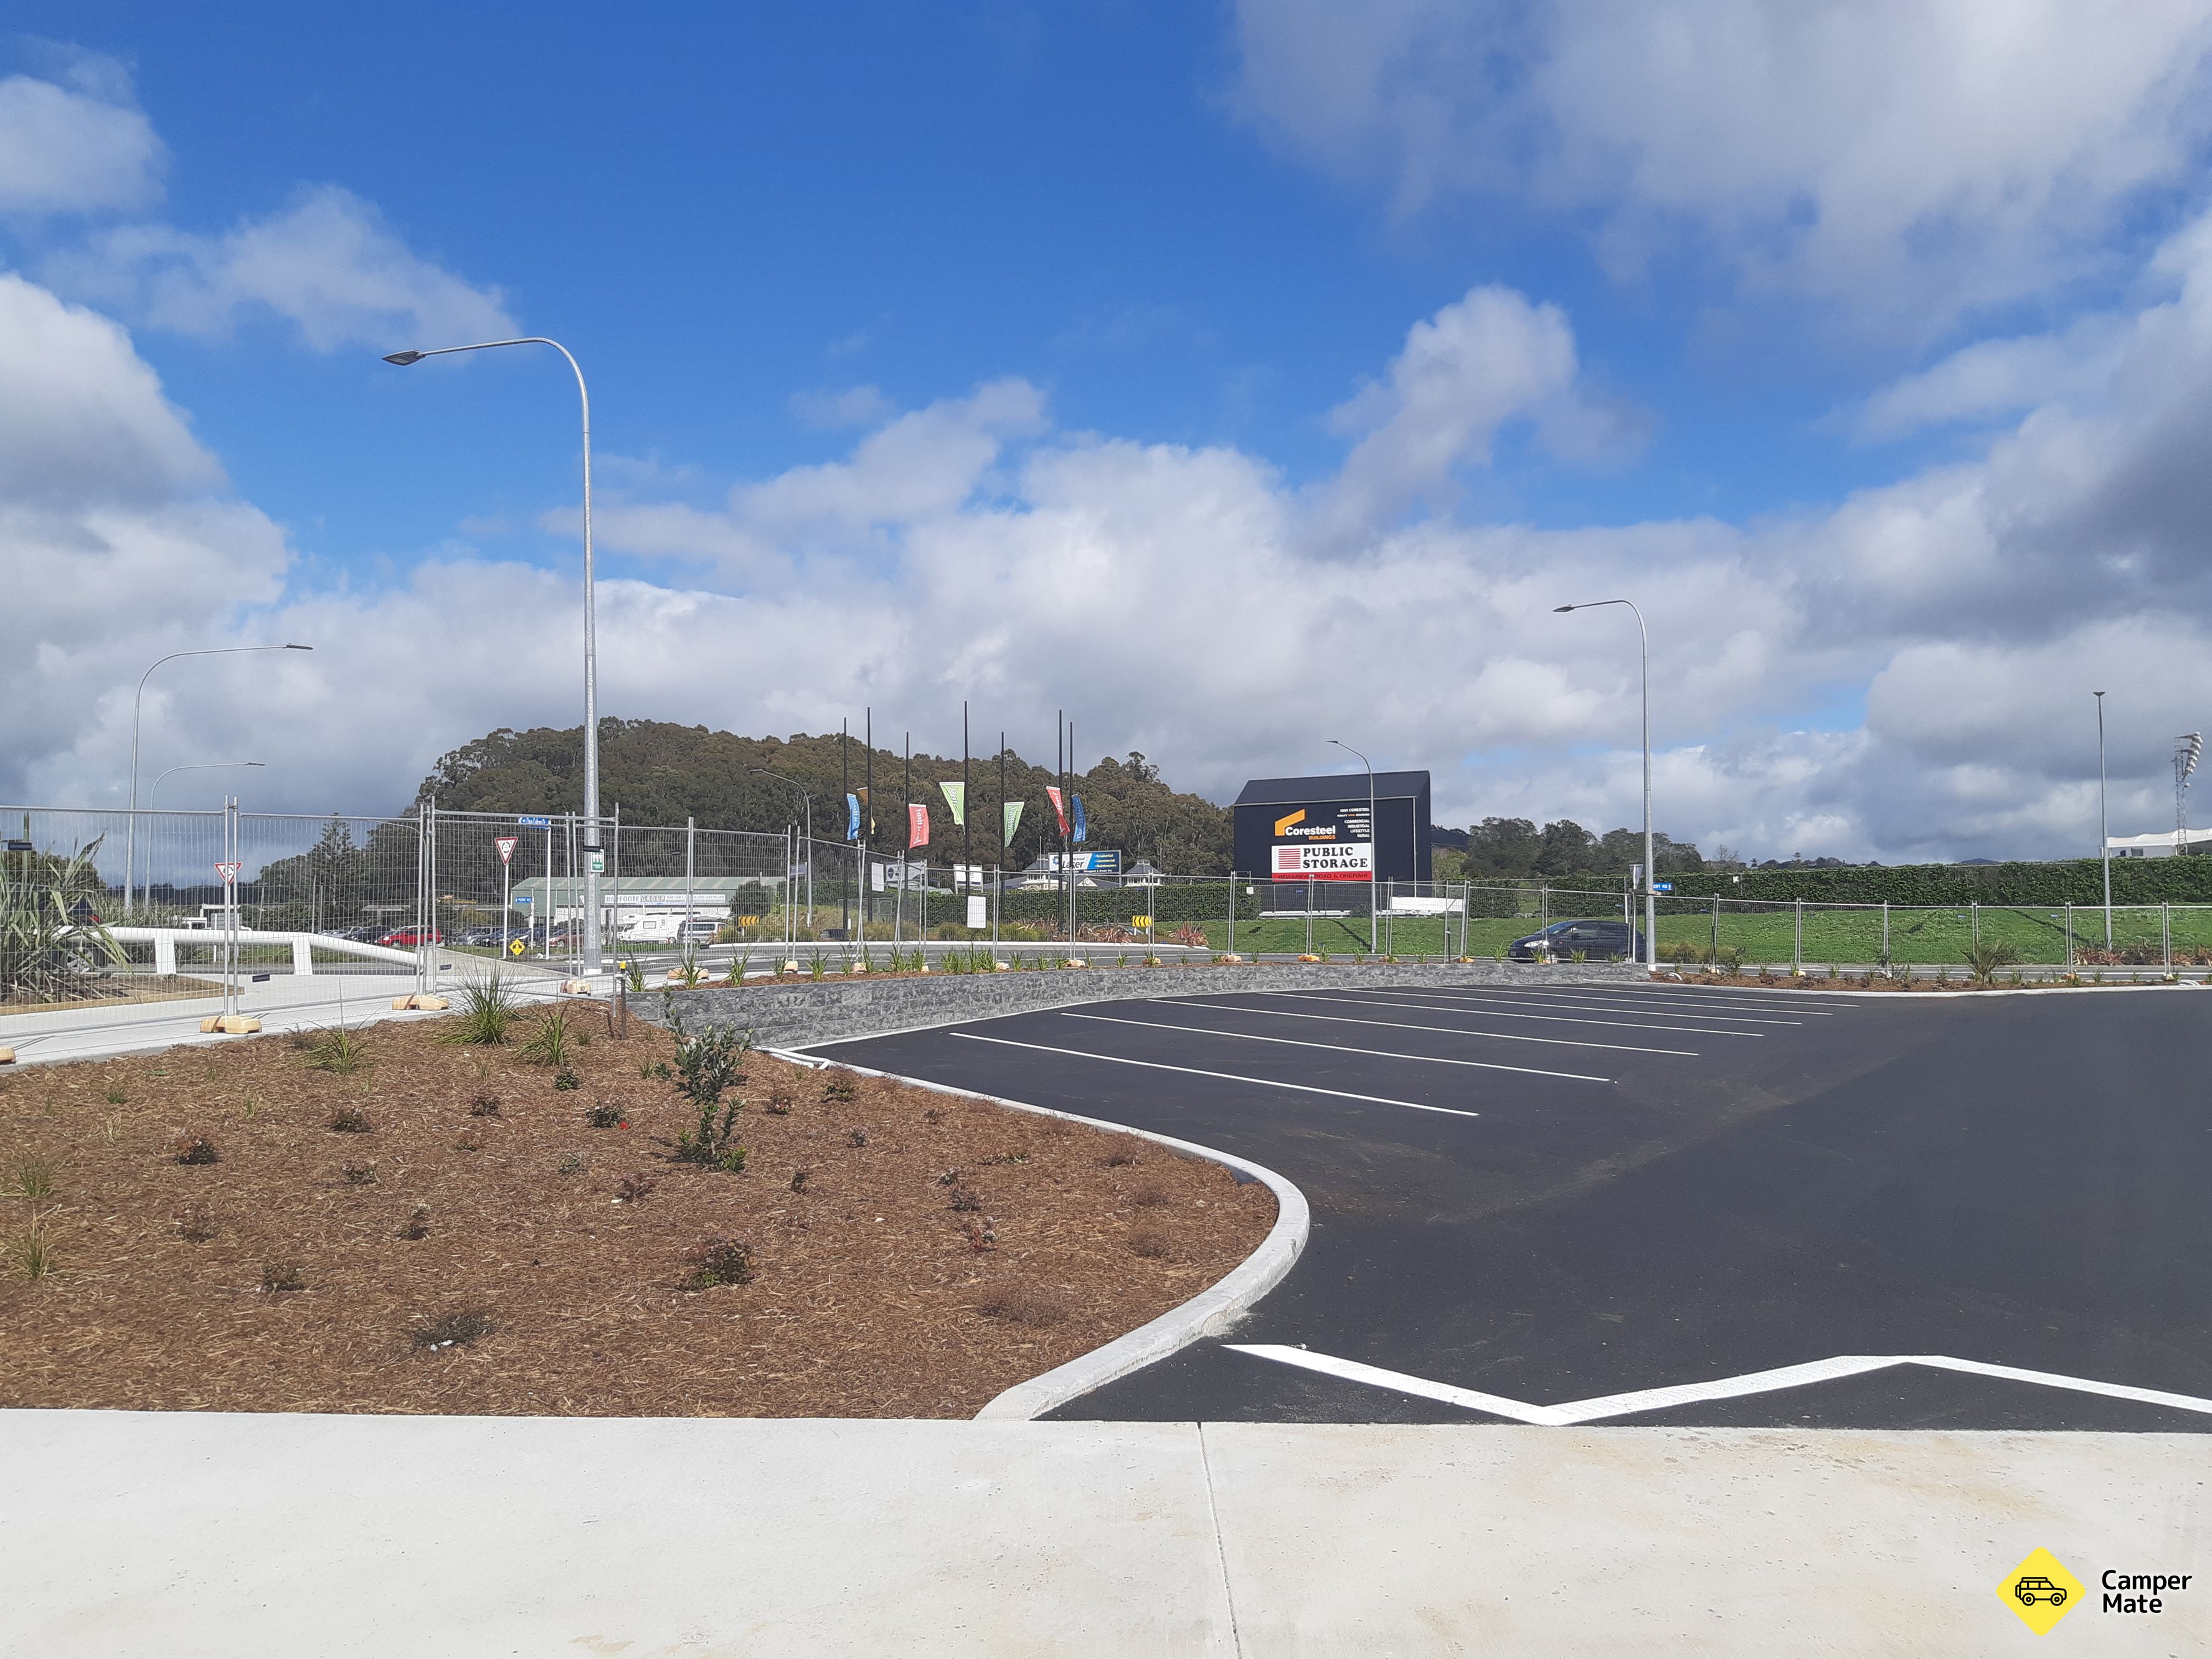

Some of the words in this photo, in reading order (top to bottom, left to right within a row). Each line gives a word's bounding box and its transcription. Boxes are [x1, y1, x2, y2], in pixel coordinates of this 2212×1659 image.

[1285, 825, 1336, 836] Coresteel
[1303, 847, 1353, 858] PUBLIC
[1303, 859, 1368, 869] STORAGE
